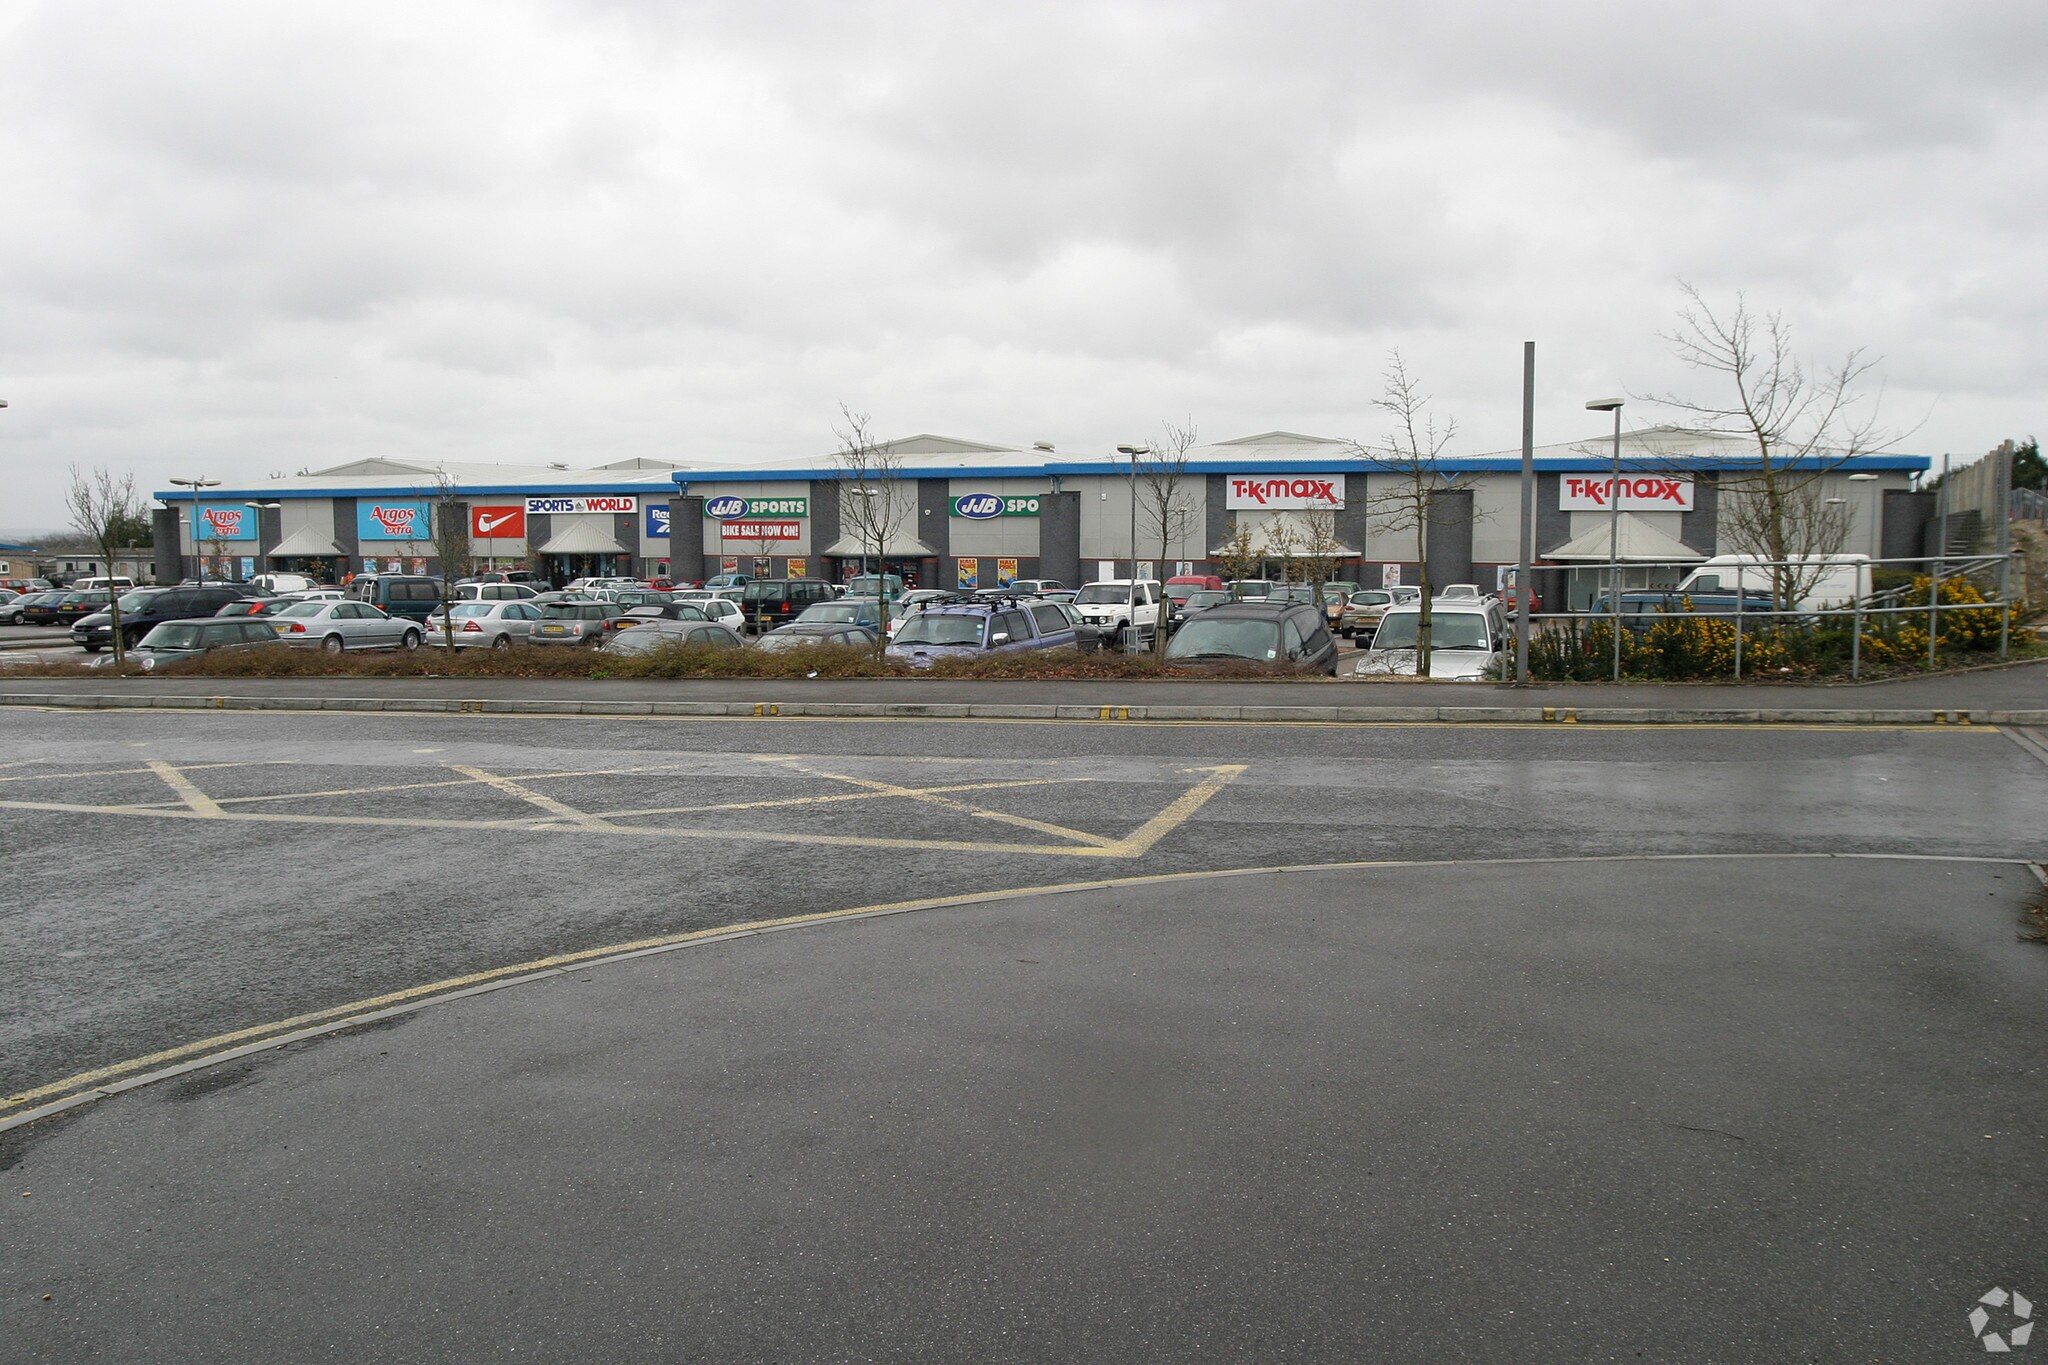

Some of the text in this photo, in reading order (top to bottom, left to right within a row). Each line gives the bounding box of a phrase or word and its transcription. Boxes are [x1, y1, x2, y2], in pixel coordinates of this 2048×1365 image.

[529, 499, 633, 511] SPORTS WORLD
[711, 501, 805, 515] JJB SPORTS
[961, 498, 1040, 514] JJB SPO
[203, 508, 242, 527] Argos
[370, 506, 415, 526] Argos
[385, 526, 412, 535] extra
[721, 525, 739, 536] BIKE
[783, 525, 799, 537] ON!
